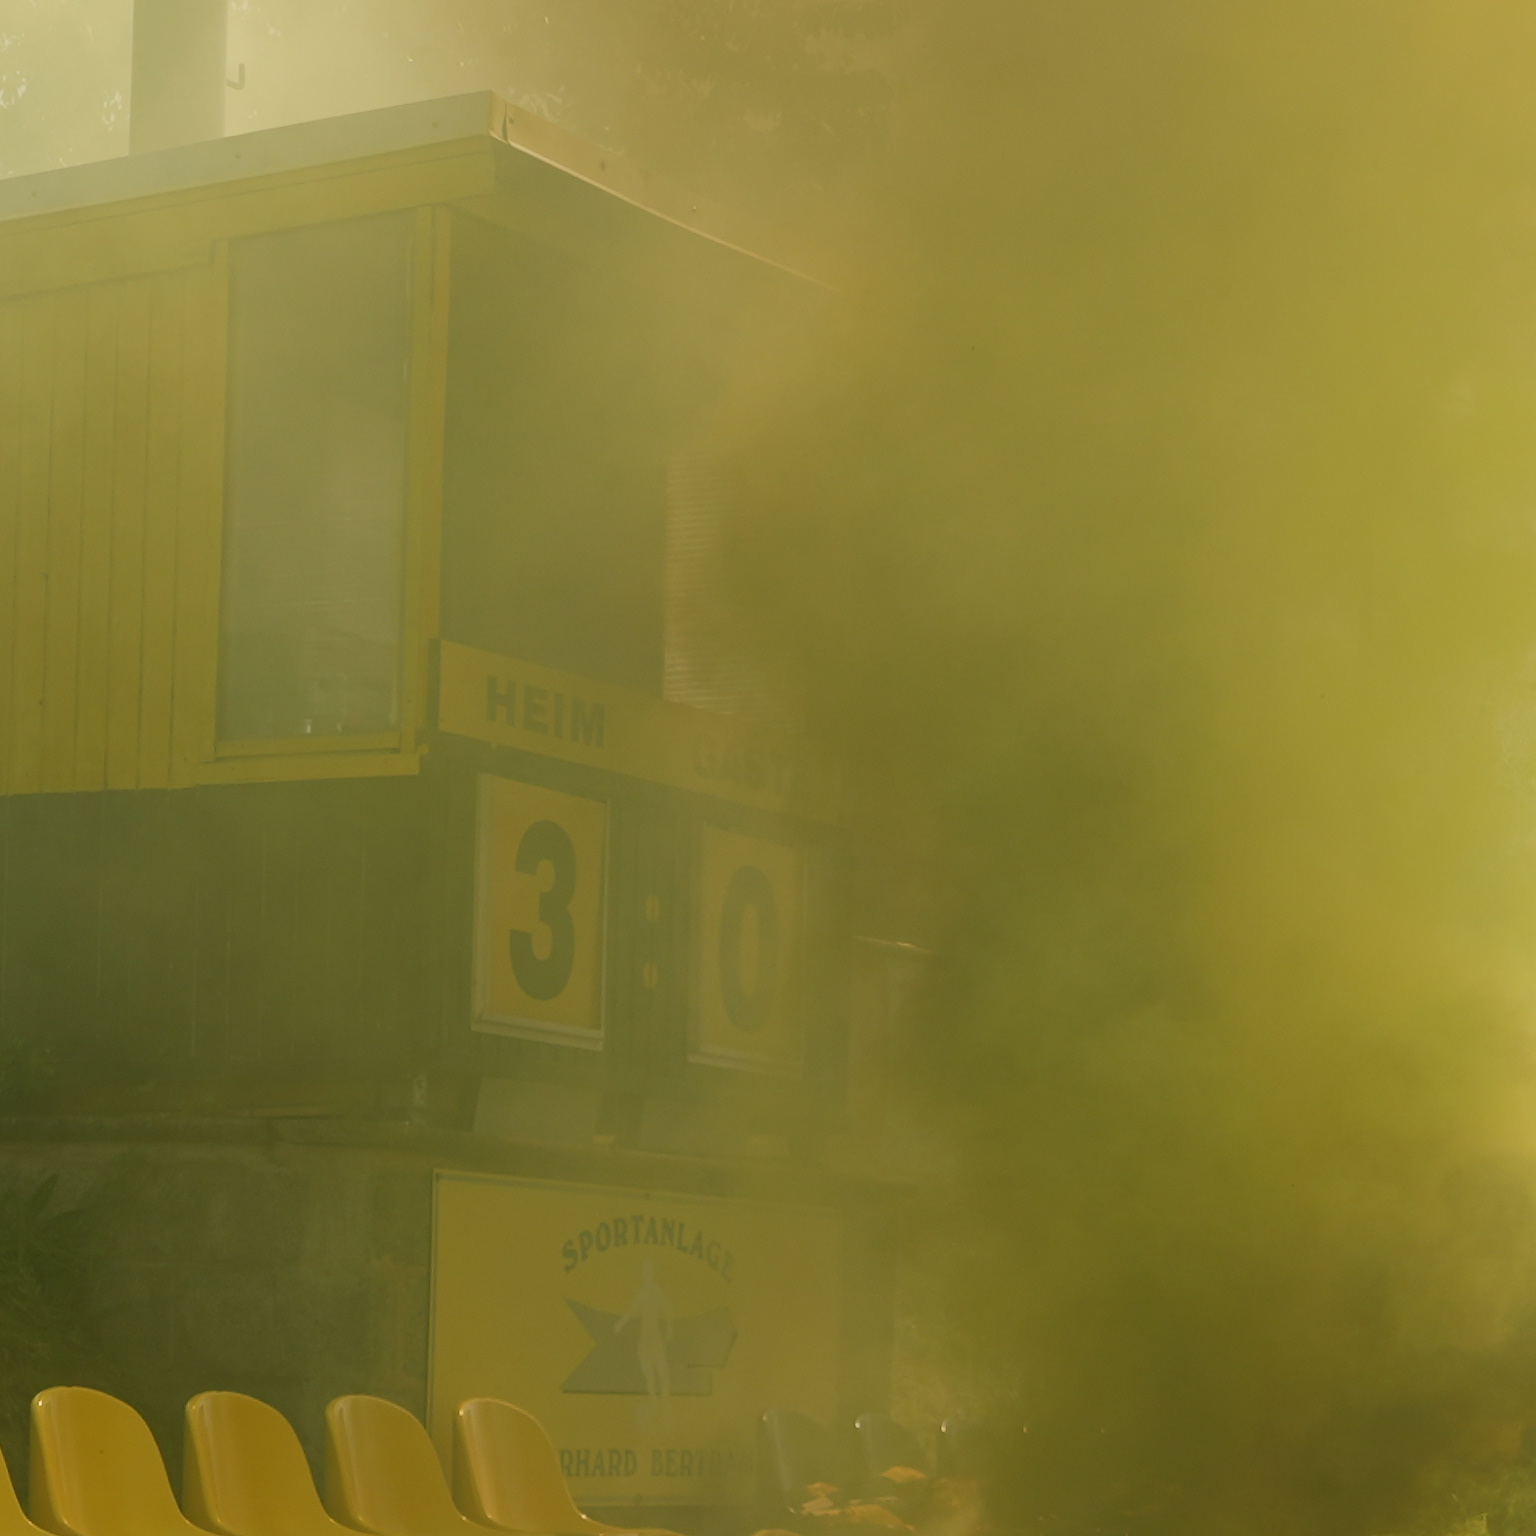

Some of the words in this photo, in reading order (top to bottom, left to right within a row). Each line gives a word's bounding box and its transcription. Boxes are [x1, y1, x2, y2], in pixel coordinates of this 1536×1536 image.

[485, 674, 606, 748] HEIM
[508, 818, 577, 1002] 3
[719, 864, 779, 1034] 0
[560, 1214, 736, 1285] SPORTANLAGE
